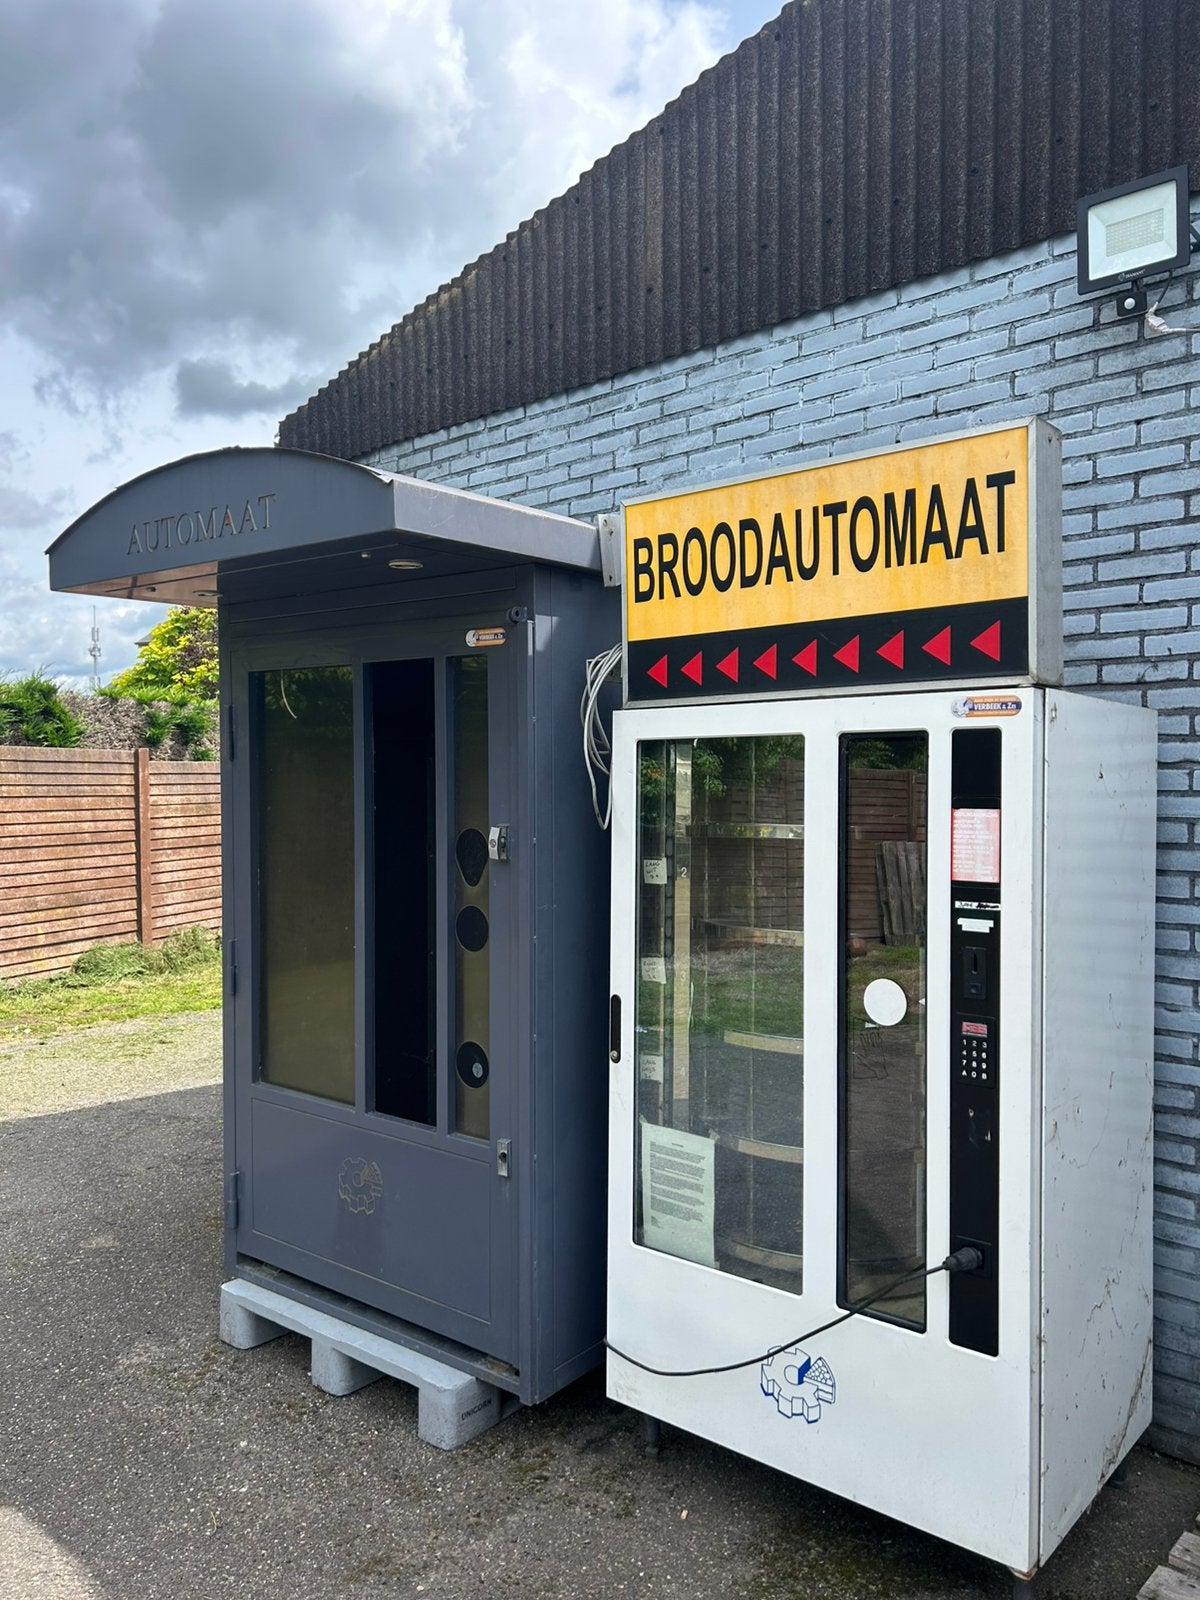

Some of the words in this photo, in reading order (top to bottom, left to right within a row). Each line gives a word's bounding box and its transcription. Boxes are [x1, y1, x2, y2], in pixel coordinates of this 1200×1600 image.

[127, 493, 276, 555] AUTOMAAT
[634, 470, 1015, 603] BROODAUTOMAAT
[974, 702, 1001, 710] VERBEEK
[681, 866, 687, 878] 2
[972, 1050, 977, 1058] 5
[972, 1060, 977, 1068] 8
